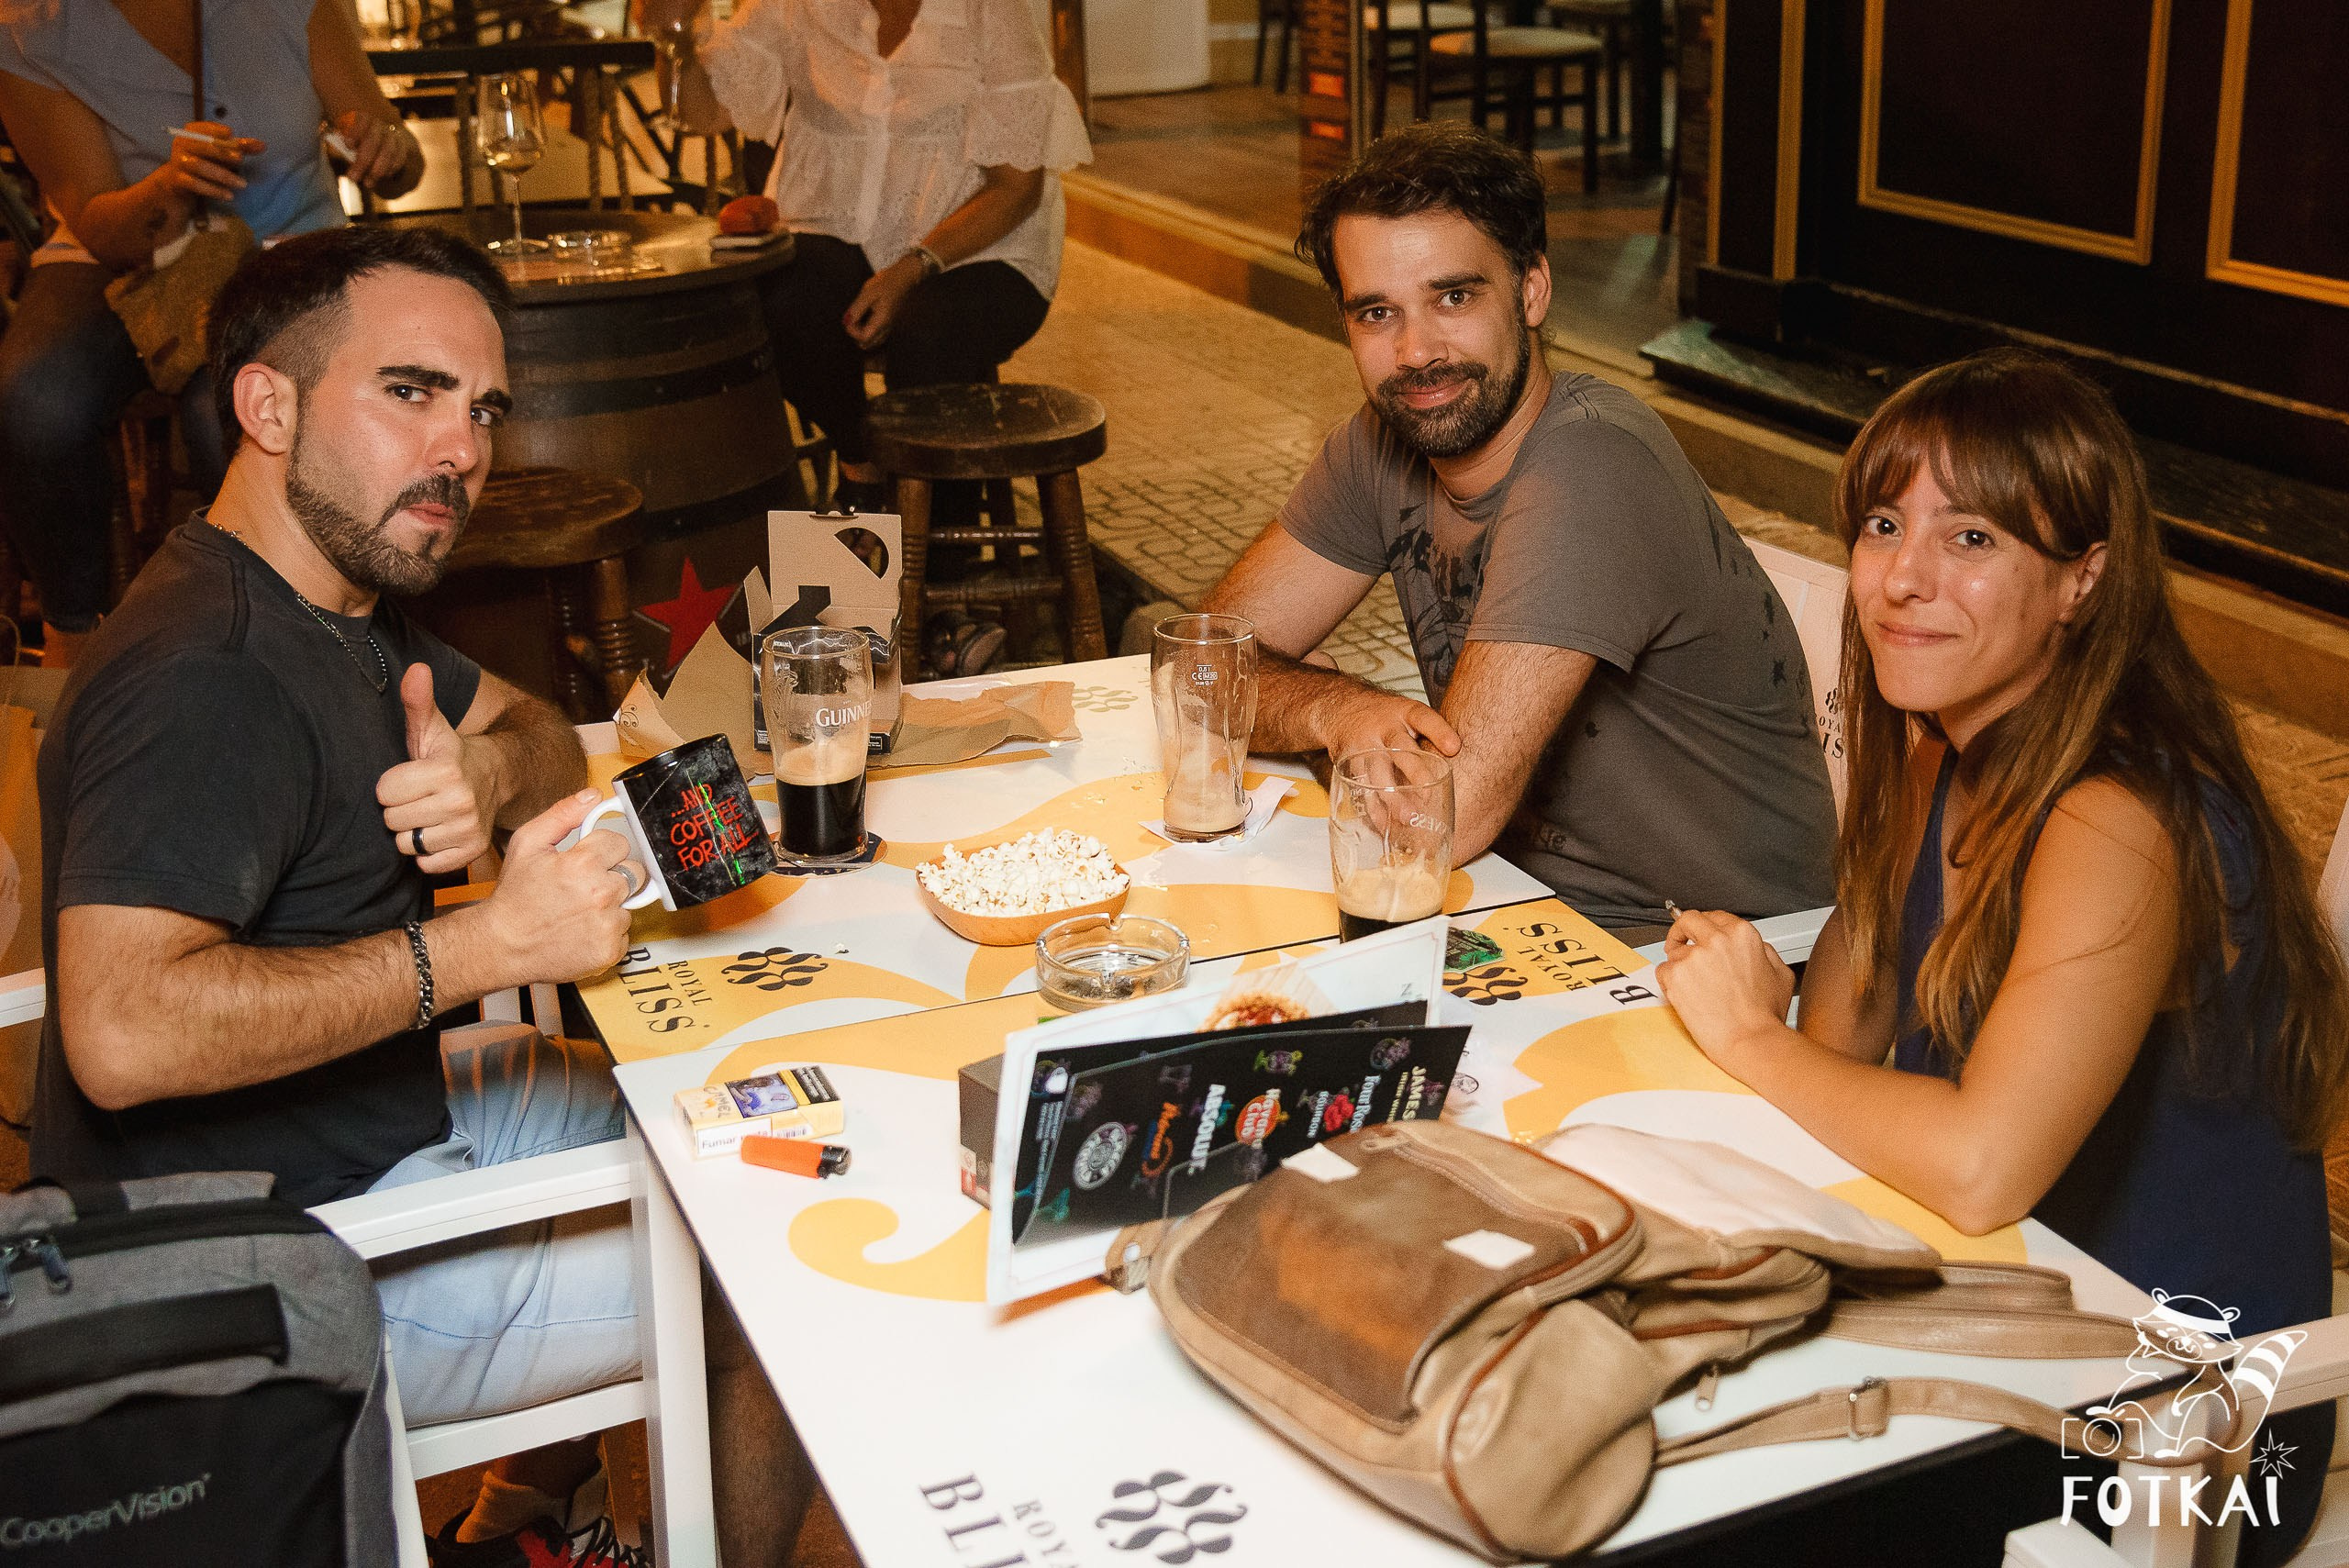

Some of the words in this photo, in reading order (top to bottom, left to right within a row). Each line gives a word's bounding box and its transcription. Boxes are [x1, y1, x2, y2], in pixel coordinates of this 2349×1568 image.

[816, 700, 872, 728] GUINNE
[1819, 716, 1841, 733] OYA
[671, 796, 743, 845] COFFEE
[677, 839, 719, 872] FOR
[719, 823, 759, 856] ALL
[667, 960, 713, 1006] ROYAL
[1516, 946, 1588, 992] ROYAL
[1517, 922, 1659, 1006] BLISS
[615, 947, 697, 1032] BLISS
[703, 1085, 732, 1118] CAMEL
[1307, 1090, 1330, 1139] BOURBON
[1402, 1066, 1427, 1121] JAMES
[1241, 1102, 1263, 1140] Club
[1251, 1088, 1281, 1149] Havana
[702, 1138, 735, 1150] Fumar
[0, 1477, 206, 1549] CooperVision
[918, 1472, 1030, 1568] BLI
[1012, 1498, 1078, 1568] ROY
